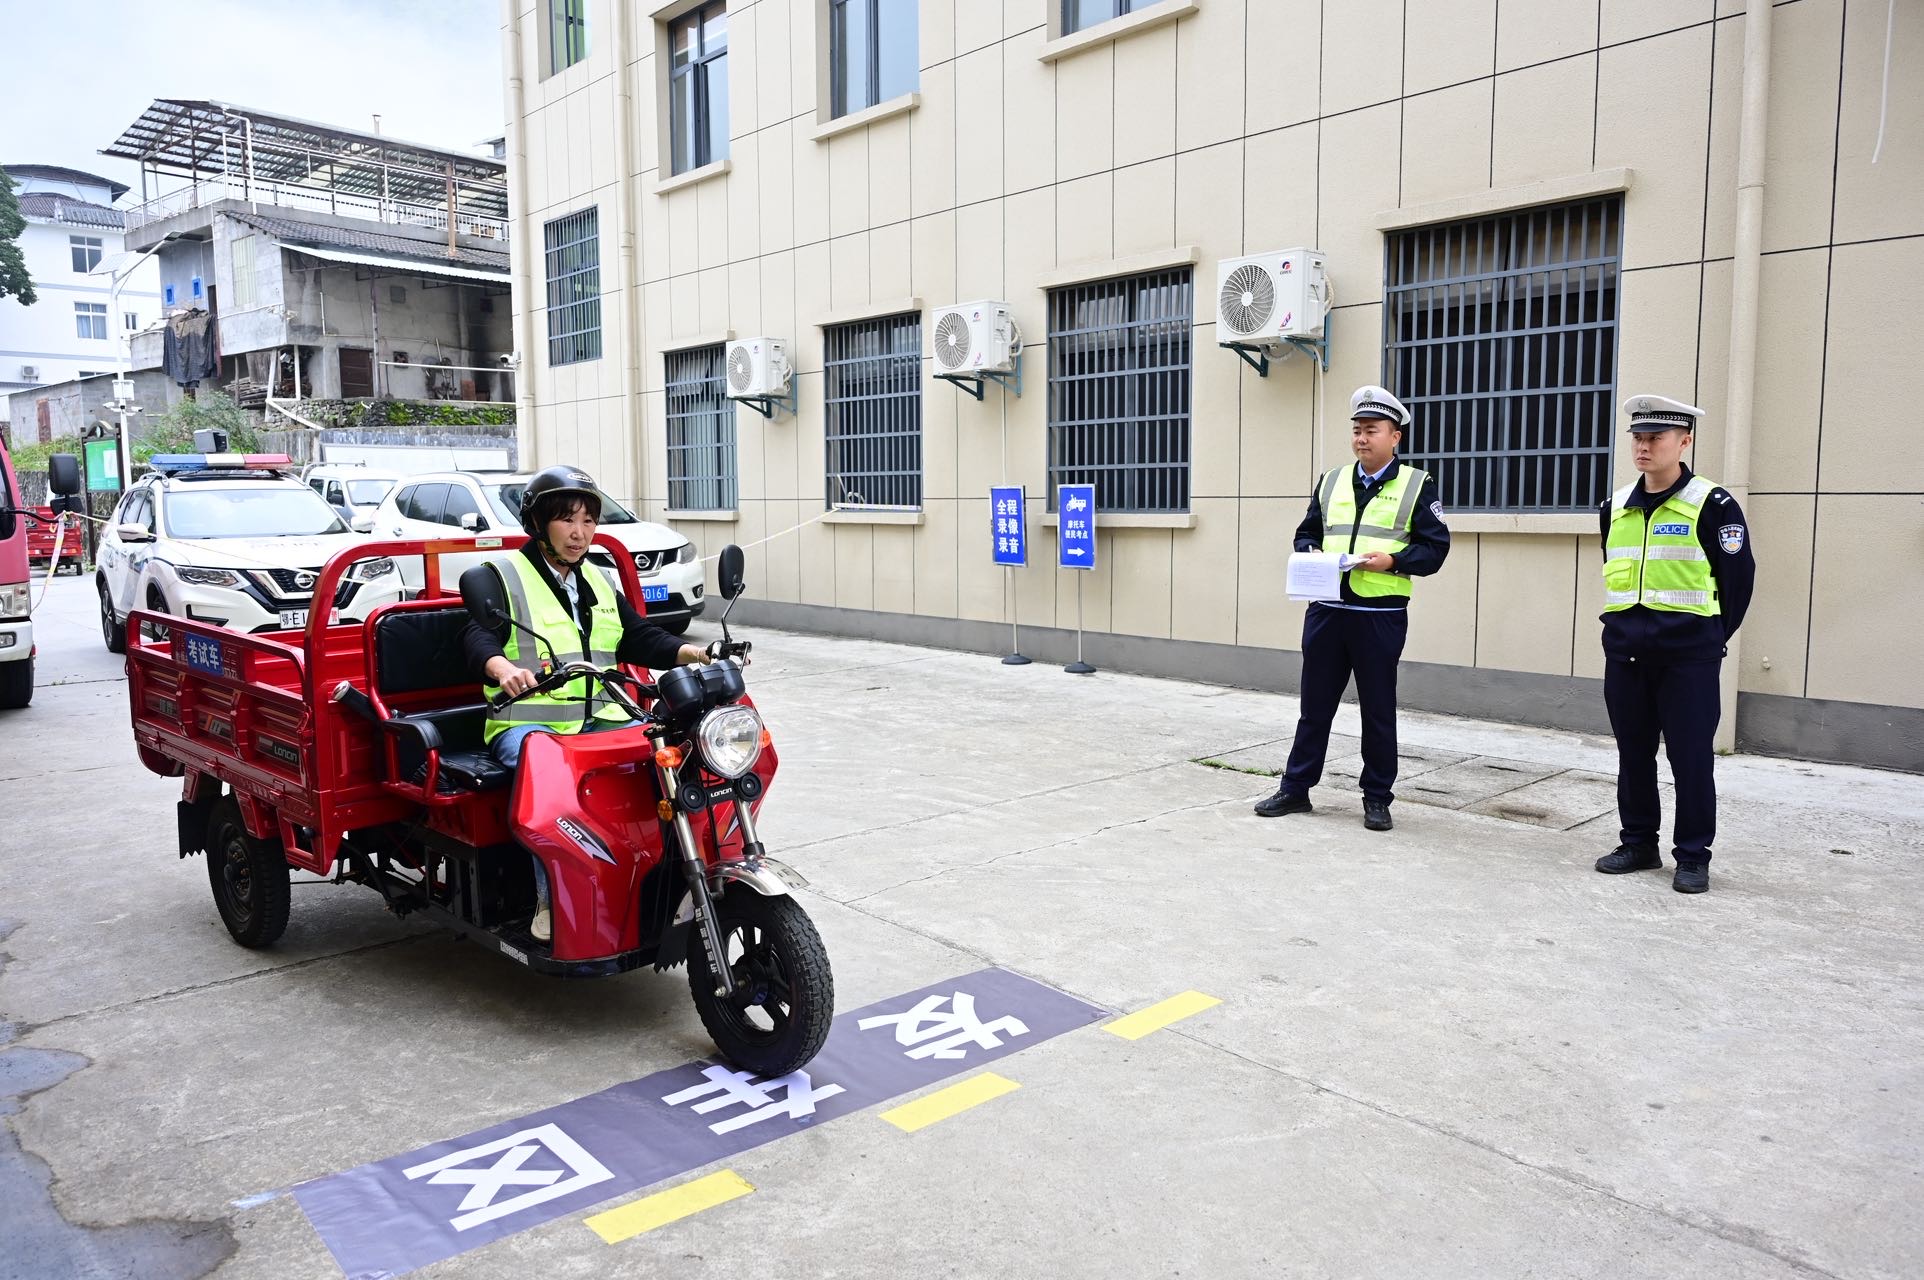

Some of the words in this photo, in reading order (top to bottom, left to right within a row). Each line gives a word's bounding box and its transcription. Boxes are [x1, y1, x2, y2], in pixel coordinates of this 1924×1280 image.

[997, 499, 1017, 515] 全程
[998, 518, 1018, 534] 录像
[1654, 526, 1687, 534] POLICE
[999, 537, 1019, 554] 录音
[188, 639, 219, 670] 考试车
